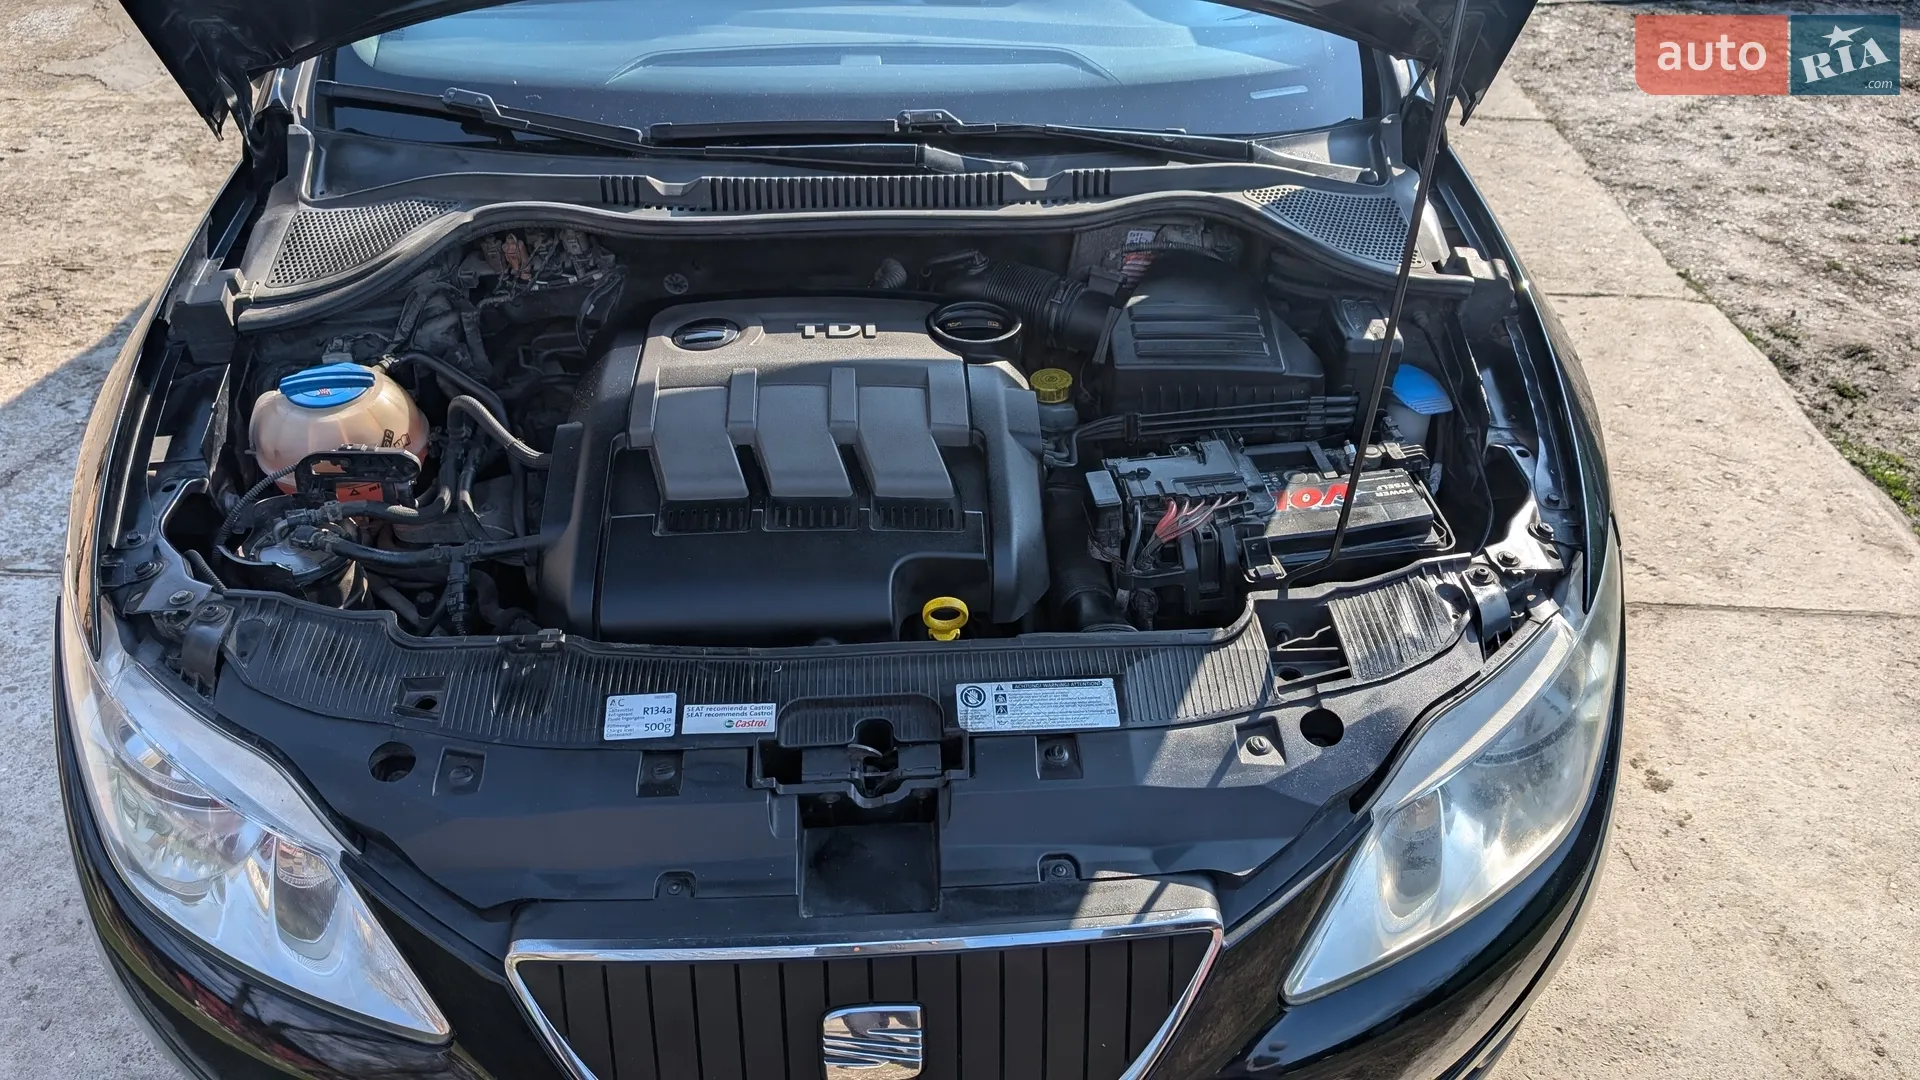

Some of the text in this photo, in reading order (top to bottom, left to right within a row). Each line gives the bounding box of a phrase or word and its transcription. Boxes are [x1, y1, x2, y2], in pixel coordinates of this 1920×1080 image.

[796, 322, 877, 338] TDI
[1375, 488, 1414, 497] POWER
[643, 706, 673, 716] R134a
[644, 722, 672, 733] 500g
[735, 719, 767, 728] Castrol
